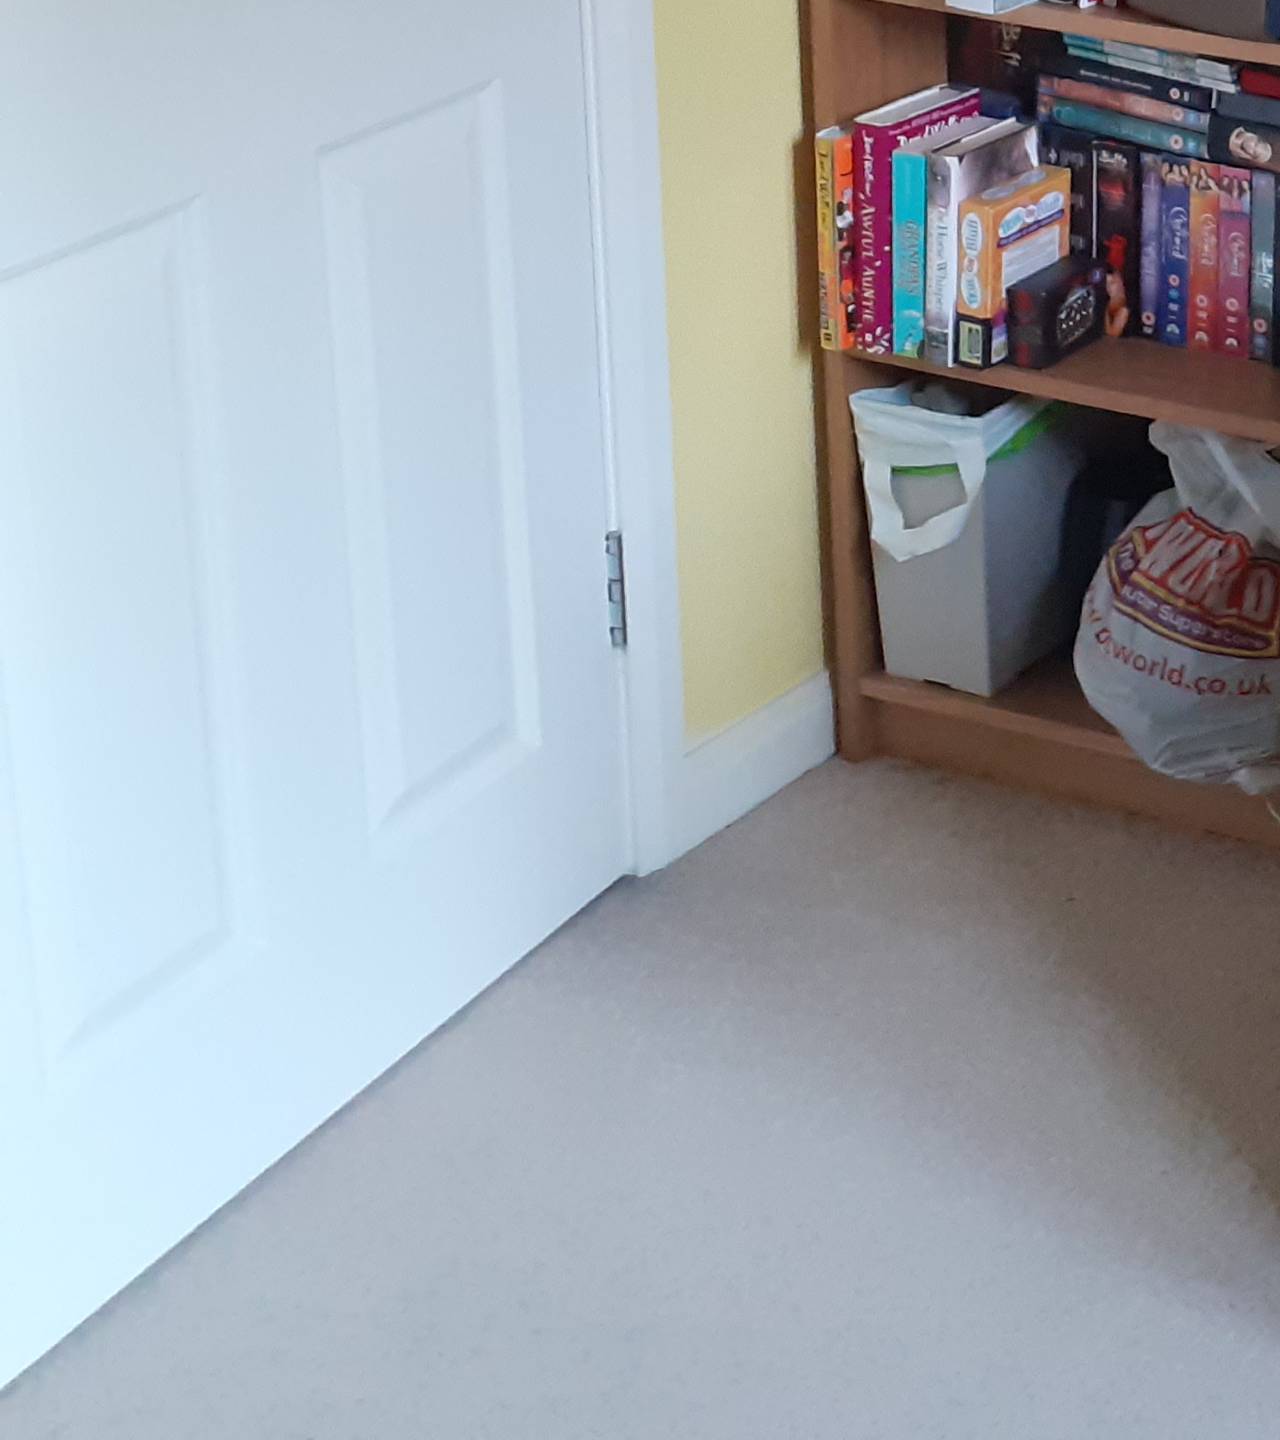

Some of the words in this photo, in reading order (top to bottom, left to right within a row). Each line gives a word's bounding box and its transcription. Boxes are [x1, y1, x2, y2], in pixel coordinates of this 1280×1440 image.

[860, 201, 875, 259] AWFUL
[936, 225, 949, 258] Horse
[860, 266, 876, 324] AUNTIE
